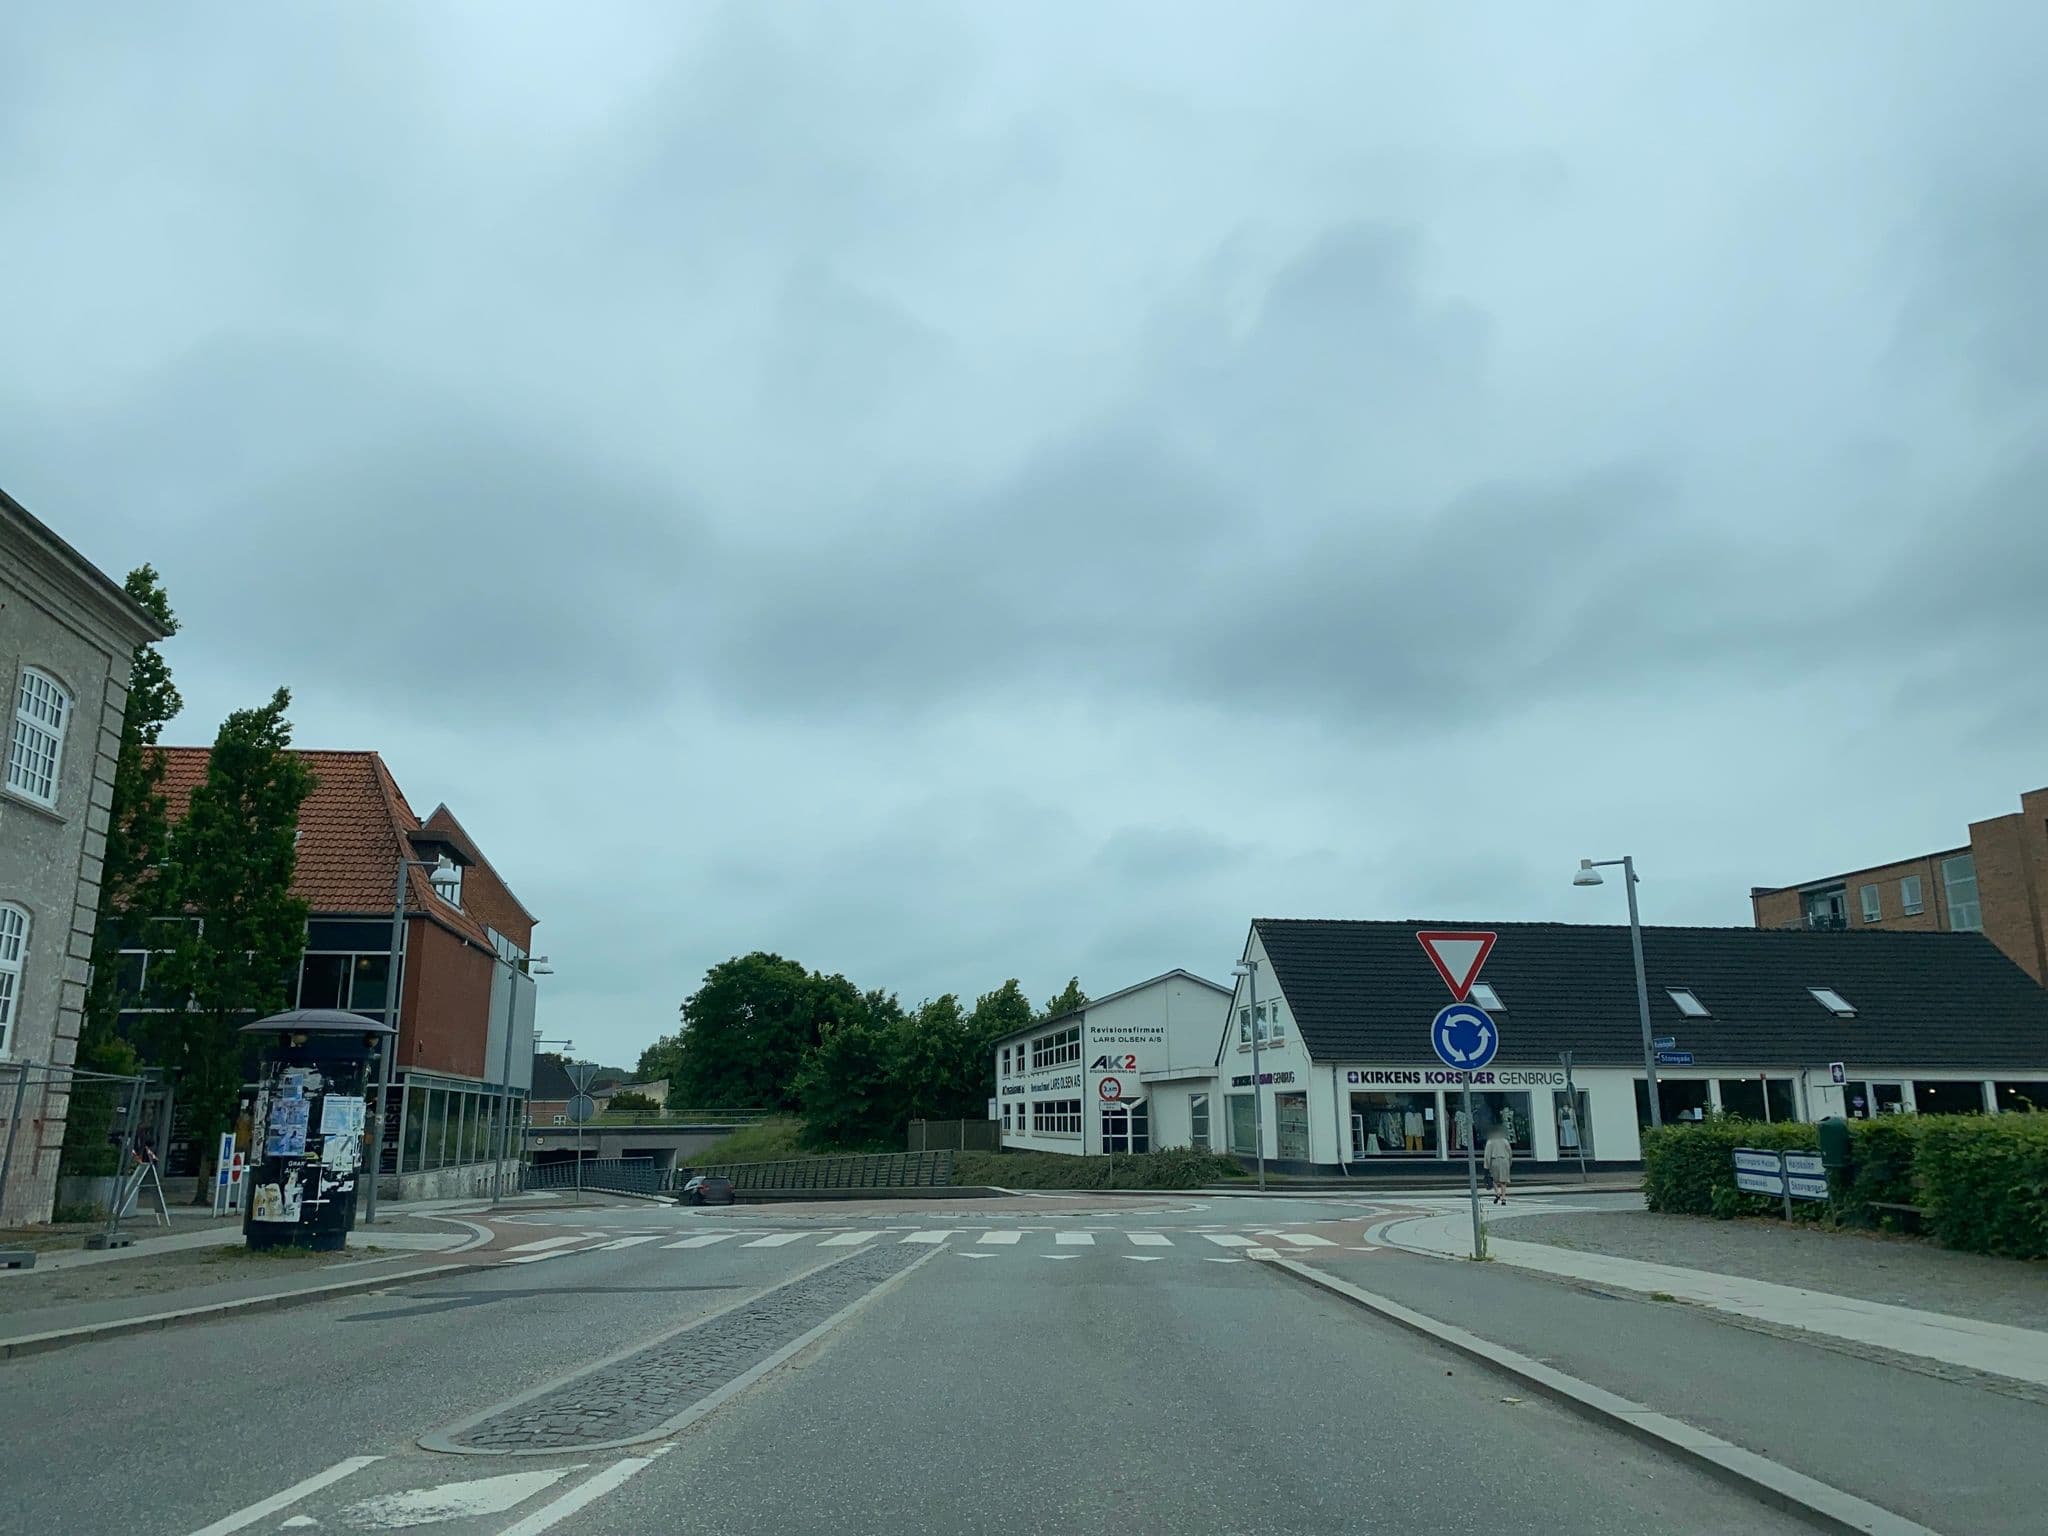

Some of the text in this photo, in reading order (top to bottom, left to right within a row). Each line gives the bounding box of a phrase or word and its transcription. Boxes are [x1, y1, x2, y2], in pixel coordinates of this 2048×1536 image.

[1090, 1026, 1164, 1034] Revisionsfirmaet
[1090, 1054, 1137, 1069] AK2
[1661, 1054, 1691, 1064] Storegade
[1361, 1070, 1421, 1084] KIRKENS
[1498, 1072, 1565, 1085] GENBRUG
